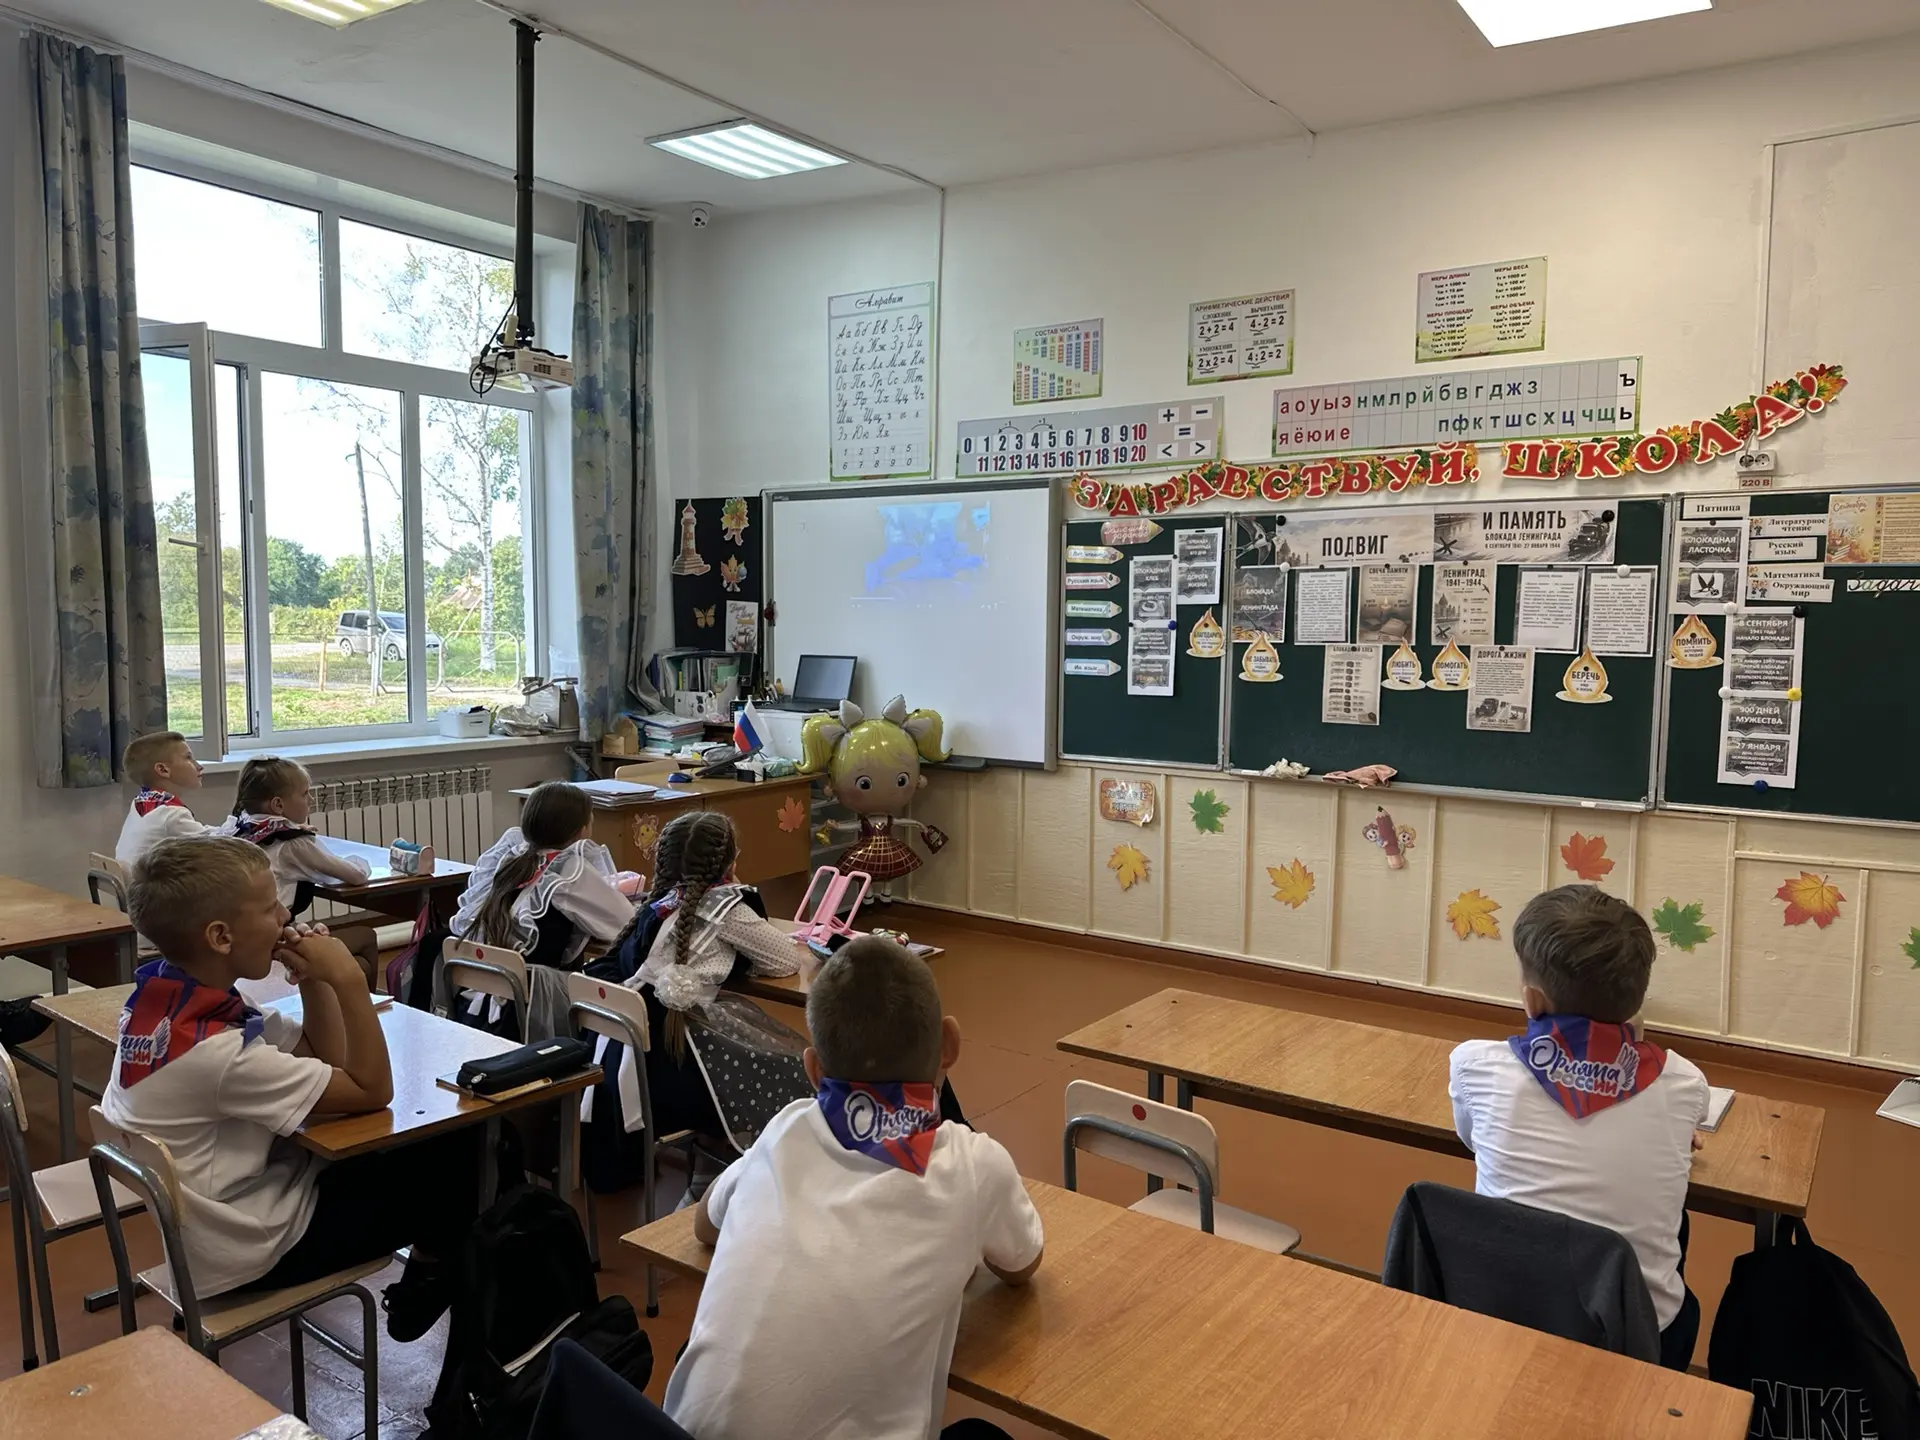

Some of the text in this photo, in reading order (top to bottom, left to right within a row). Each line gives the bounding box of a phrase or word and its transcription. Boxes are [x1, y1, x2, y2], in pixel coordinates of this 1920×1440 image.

[1502, 374, 1825, 480] ШКОЛА!
[964, 438, 971, 453] 0
[999, 435, 1006, 451] 2
[1016, 434, 1023, 450] 3
[1031, 433, 1039, 449] 4
[1049, 432, 1056, 448] 5
[1066, 430, 1073, 446] 6
[1101, 427, 1109, 444] 8
[1120, 425, 1128, 442] 9
[1132, 424, 1146, 441] 10
[978, 445, 1145, 472] 11 12 13 14 15 16 17 18 19 20
[1697, 504, 1740, 512] Пятница
[1483, 511, 1566, 529] И ПАМЯТЬ
[1768, 518, 1826, 527] Литературное
[1485, 532, 1561, 541] БЛОКАДА ЛЕНИНГРАДА
[1323, 535, 1388, 556] ПОДВИГ
[1688, 546, 1731, 554] ЛАСТОЧКА
[1764, 571, 1820, 580] Математика
[1773, 582, 1830, 591] Окружающий
[1791, 590, 1810, 598] мир
[1676, 638, 1712, 646] ПОМНИТЬ
[1504, 651, 1526, 659] ЖИЗНИ
[1572, 671, 1600, 680] БЕРЕЧЬ
[1756, 706, 1780, 714] ДНЕЙ
[1736, 716, 1782, 724] МУЖЕСТВА
[1532, 1037, 1620, 1082] Орлята
[1751, 1379, 1878, 1440] NIKE
